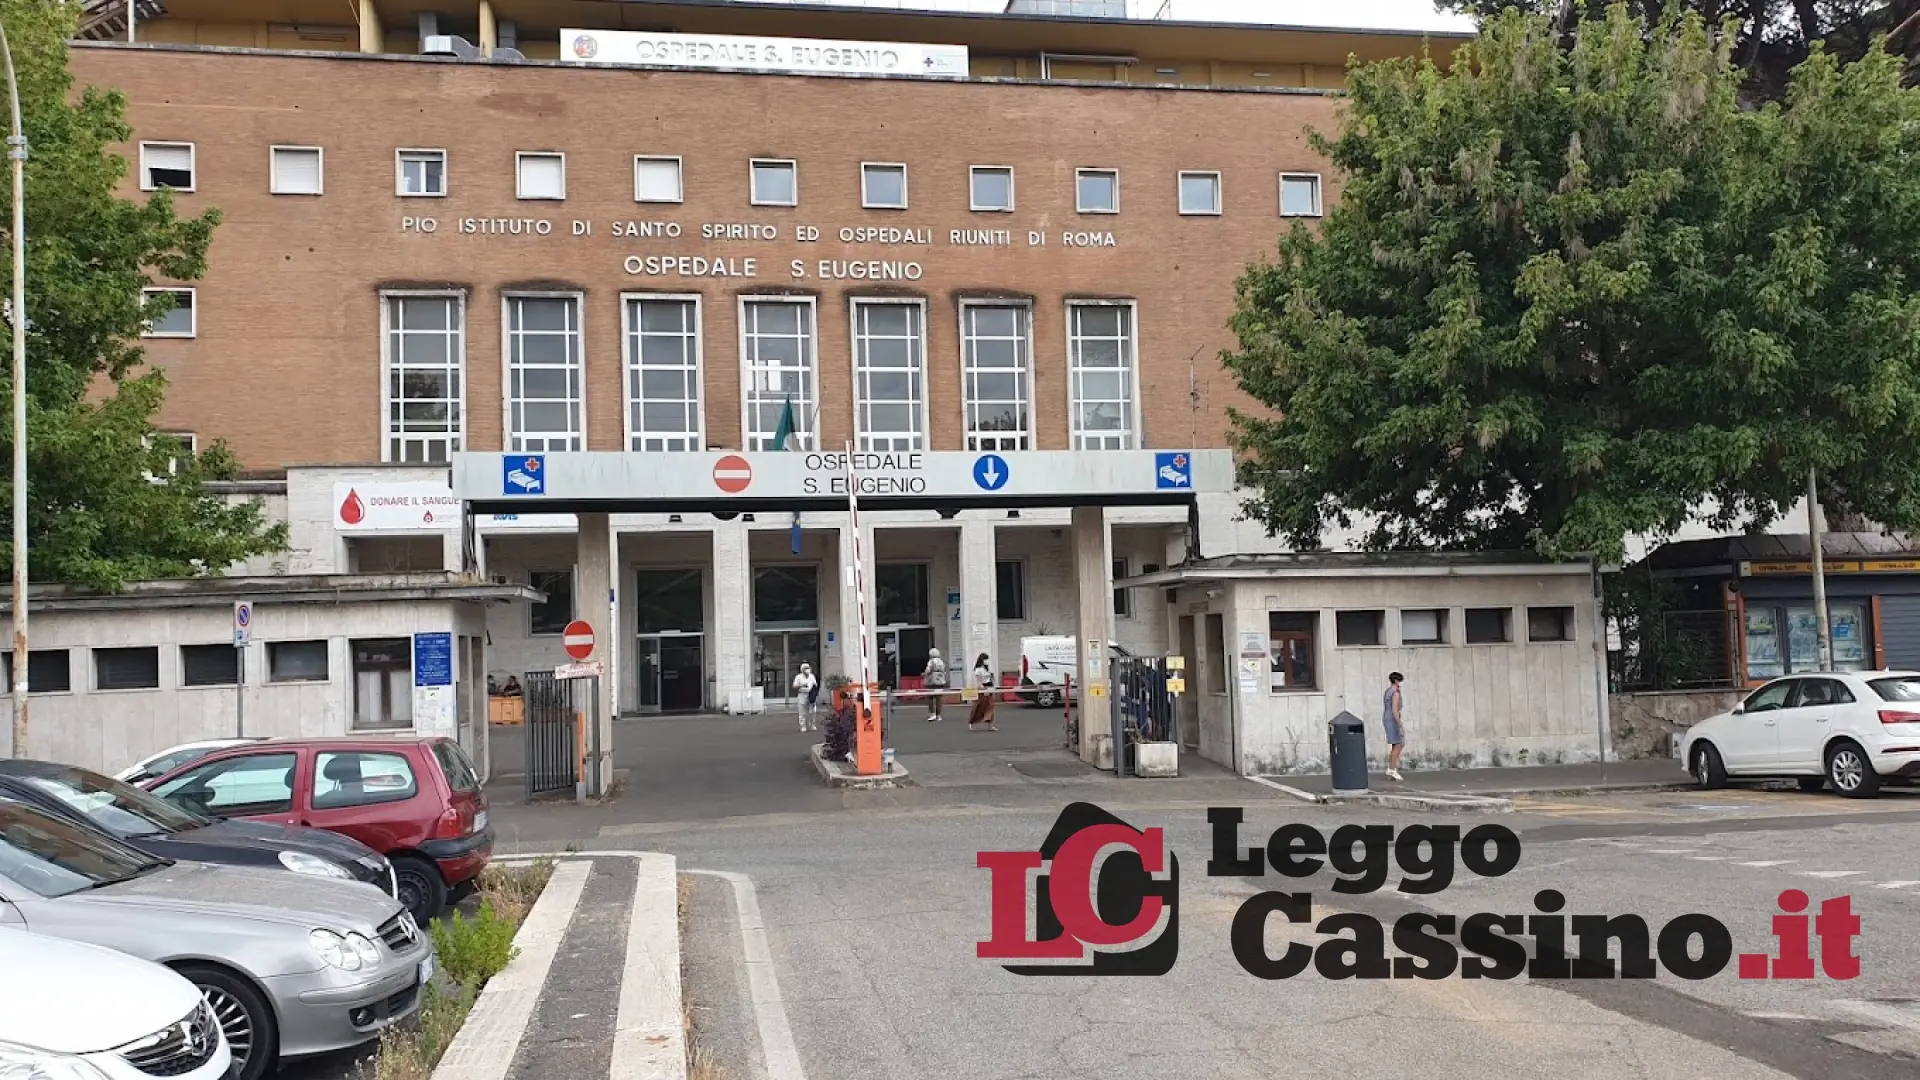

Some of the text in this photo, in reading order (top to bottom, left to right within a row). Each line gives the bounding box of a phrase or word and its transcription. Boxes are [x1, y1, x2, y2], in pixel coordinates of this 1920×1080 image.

[636, 40, 900, 68] OSPEDALE S. EUGENIO
[402, 217, 1116, 247] PIO ISTITUTO DI SANTO SPIRITO ED OSPEDALI RIUNITI DI ROMA
[624, 255, 923, 280] OSPEDALE S. EUGENIO
[804, 454, 926, 494] OSPEDALE S. EUGENIO
[370, 496, 460, 506] DONARE IL SANGUE
